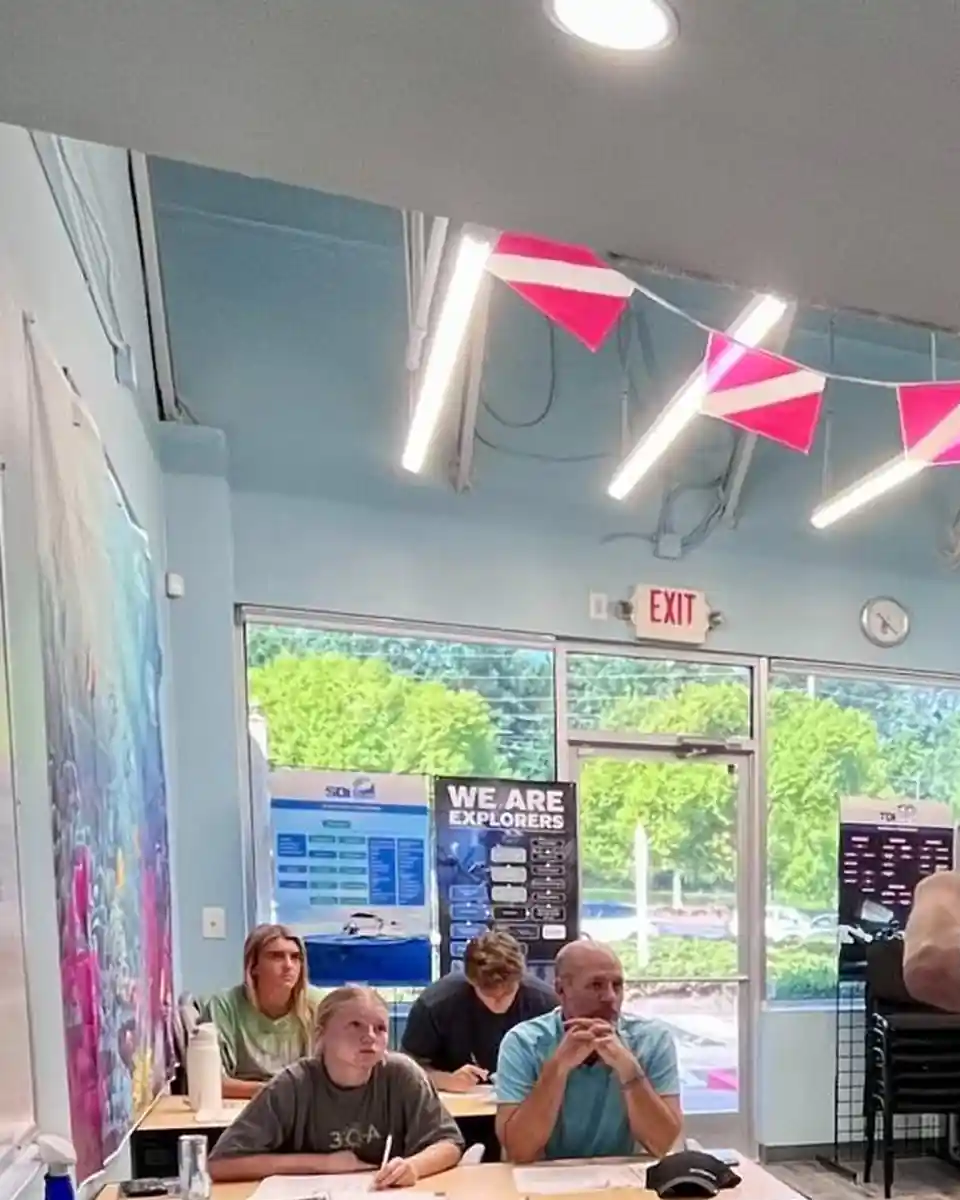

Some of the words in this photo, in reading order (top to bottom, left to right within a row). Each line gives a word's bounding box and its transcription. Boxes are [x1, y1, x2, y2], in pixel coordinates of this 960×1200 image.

[650, 590, 696, 626] EXIT
[447, 785, 496, 810] WE
[504, 788, 565, 812] ARE
[448, 810, 565, 829] EXPLORERS
